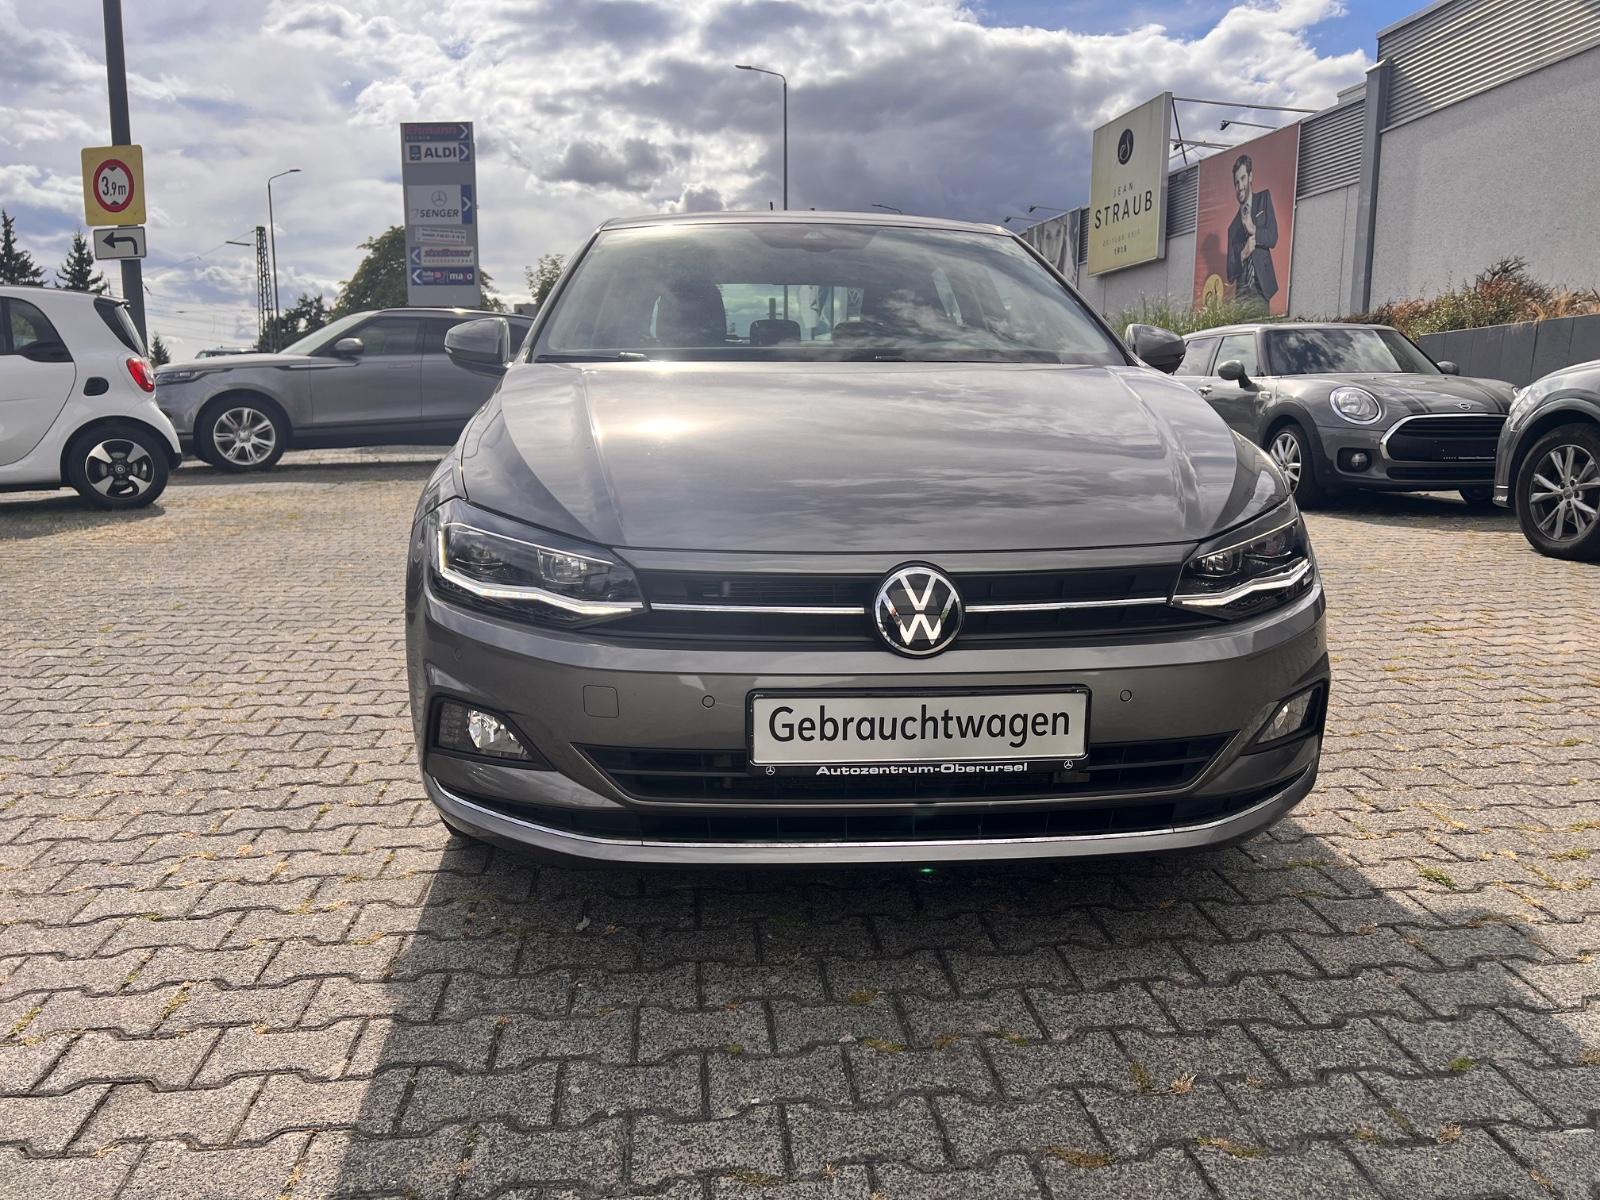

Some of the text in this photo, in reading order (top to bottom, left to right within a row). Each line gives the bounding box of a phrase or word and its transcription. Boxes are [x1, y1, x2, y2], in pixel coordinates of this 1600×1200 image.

[424, 147, 457, 158] ALDI
[1113, 182, 1133, 198] JEAN
[420, 208, 459, 218] SENGER
[1095, 190, 1152, 229] STRAUB
[768, 704, 1070, 749] Gebrauchtwagen
[815, 762, 1028, 776] Autozentrum-Oberursel
